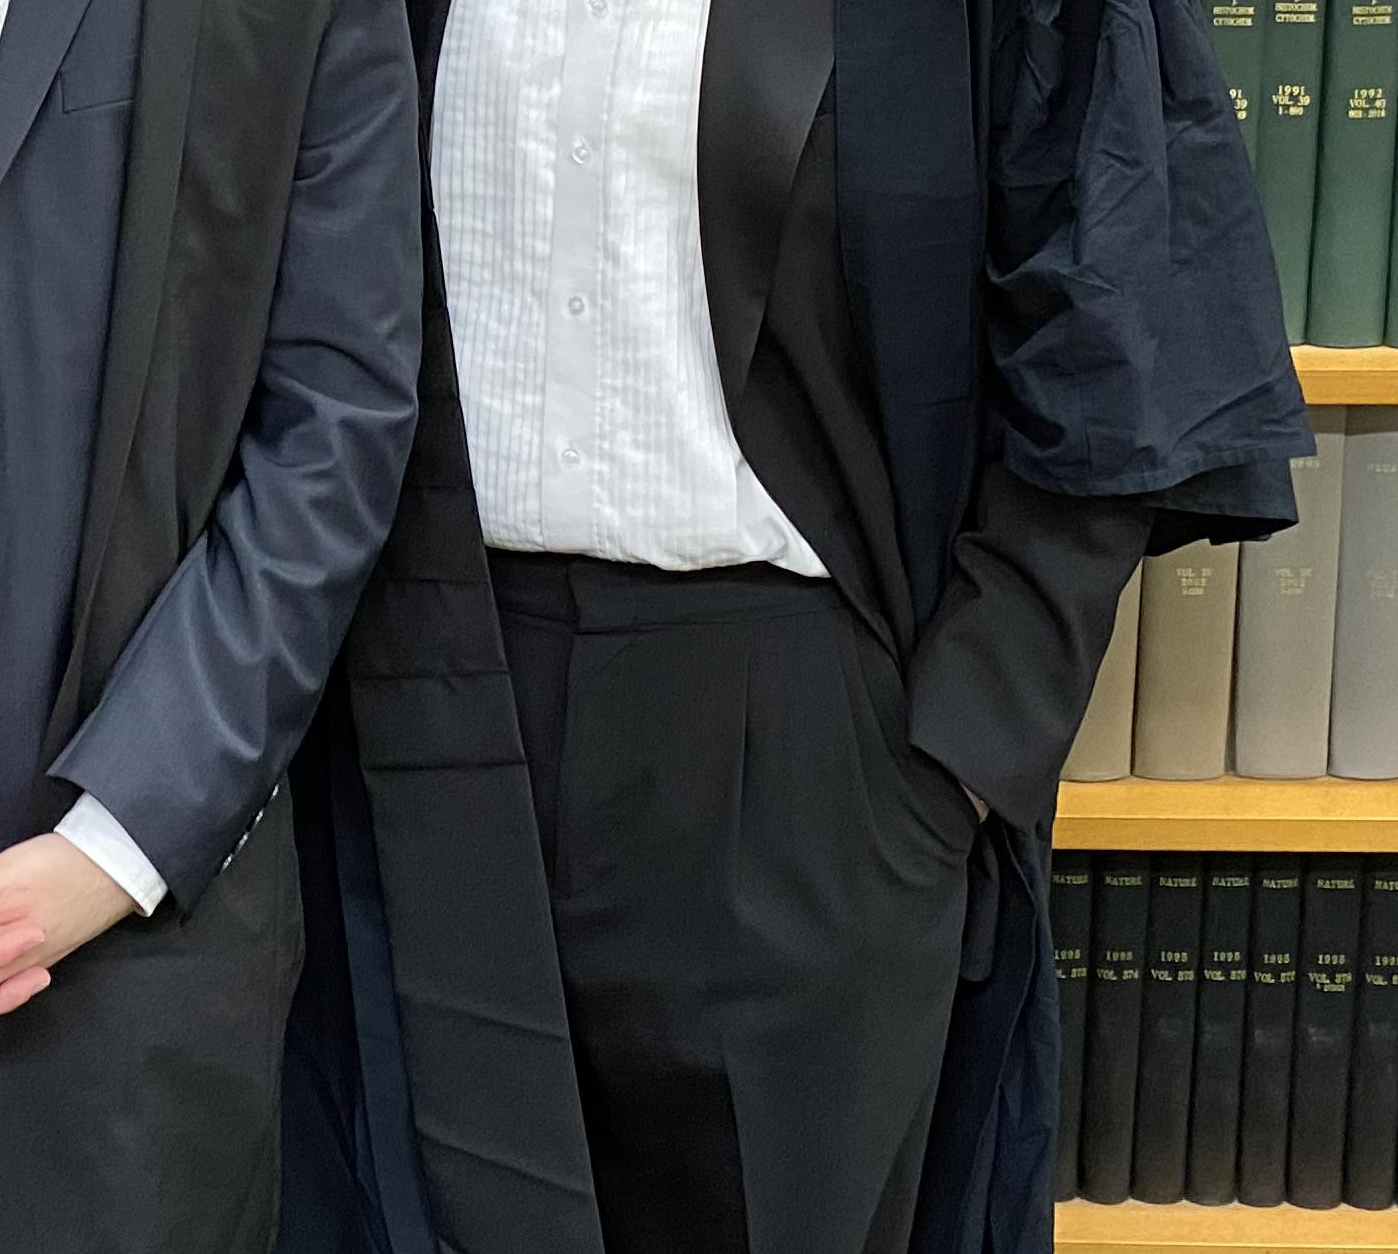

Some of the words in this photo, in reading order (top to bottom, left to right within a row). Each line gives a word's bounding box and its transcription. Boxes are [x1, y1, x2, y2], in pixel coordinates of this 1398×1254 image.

[1278, 86, 1307, 96] 1991
[1354, 89, 1383, 99] 1992
[1160, 878, 1197, 887] NATURE
[1212, 877, 1249, 886] NATURE
[1263, 879, 1298, 888] NATURE
